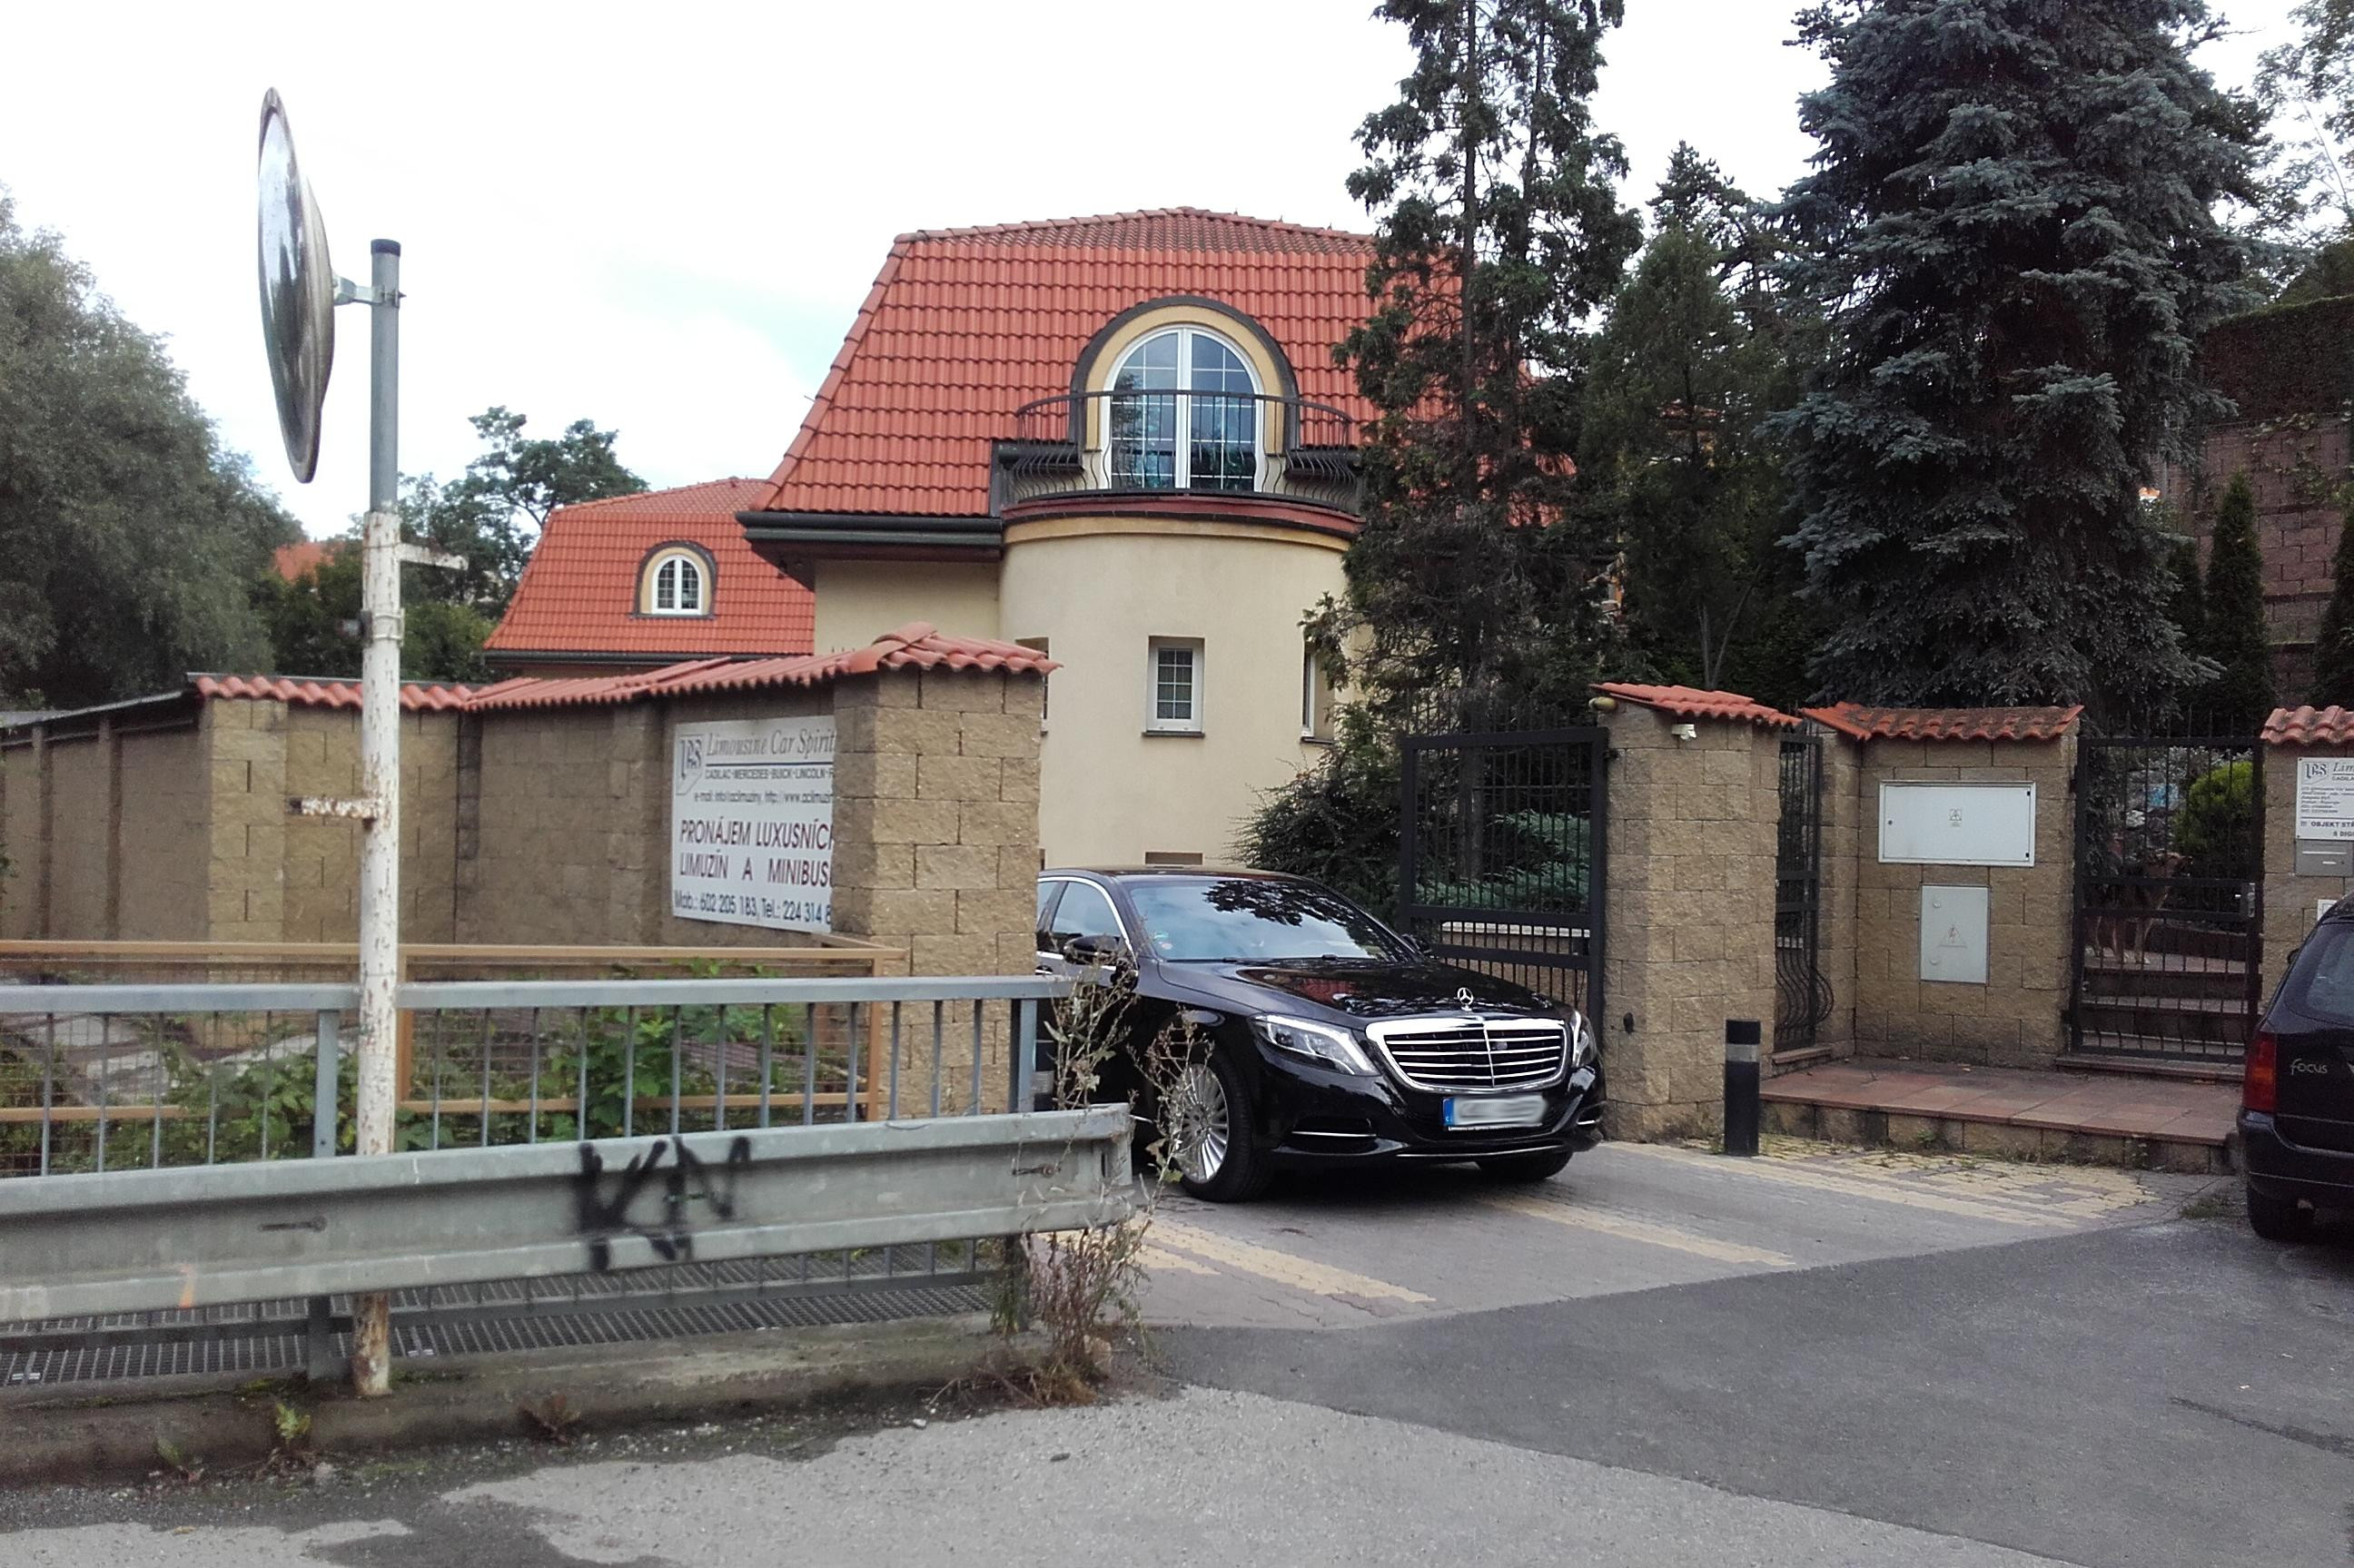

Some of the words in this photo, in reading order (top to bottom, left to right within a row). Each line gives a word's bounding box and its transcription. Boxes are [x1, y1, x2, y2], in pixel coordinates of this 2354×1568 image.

[706, 732, 767, 755] Limousine
[770, 729, 795, 754] Car
[796, 728, 836, 759] Spirit
[679, 815, 751, 846] PRONÁJEM
[679, 849, 729, 880] LIMUZÍN
[741, 856, 753, 882] A
[767, 857, 834, 889] MINIBUS
[700, 892, 717, 912] 602
[783, 900, 802, 922] 224
[805, 902, 823, 922] 314
